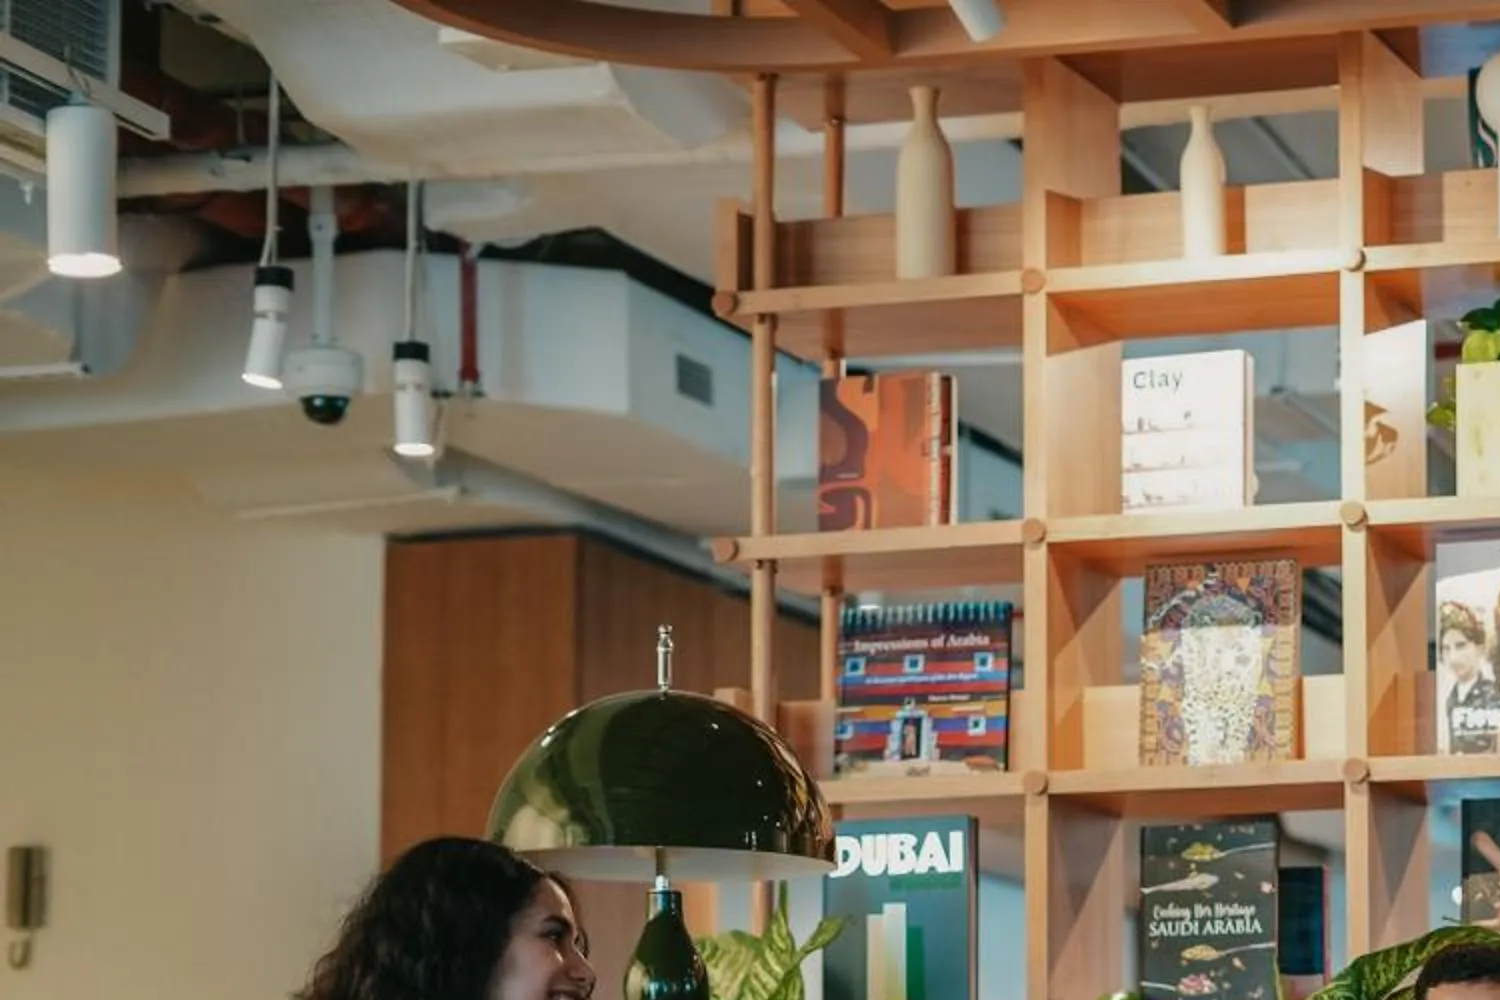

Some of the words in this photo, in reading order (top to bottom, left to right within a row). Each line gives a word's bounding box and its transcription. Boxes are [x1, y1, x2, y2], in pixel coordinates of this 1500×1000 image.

[1133, 370, 1183, 393] Clay
[853, 638, 929, 656] Impressions
[931, 633, 945, 648] of
[946, 632, 990, 648] Arabia
[828, 830, 965, 879] DUBAI
[1149, 920, 1200, 937] SAUDI
[1201, 917, 1263, 936] ARABIA
